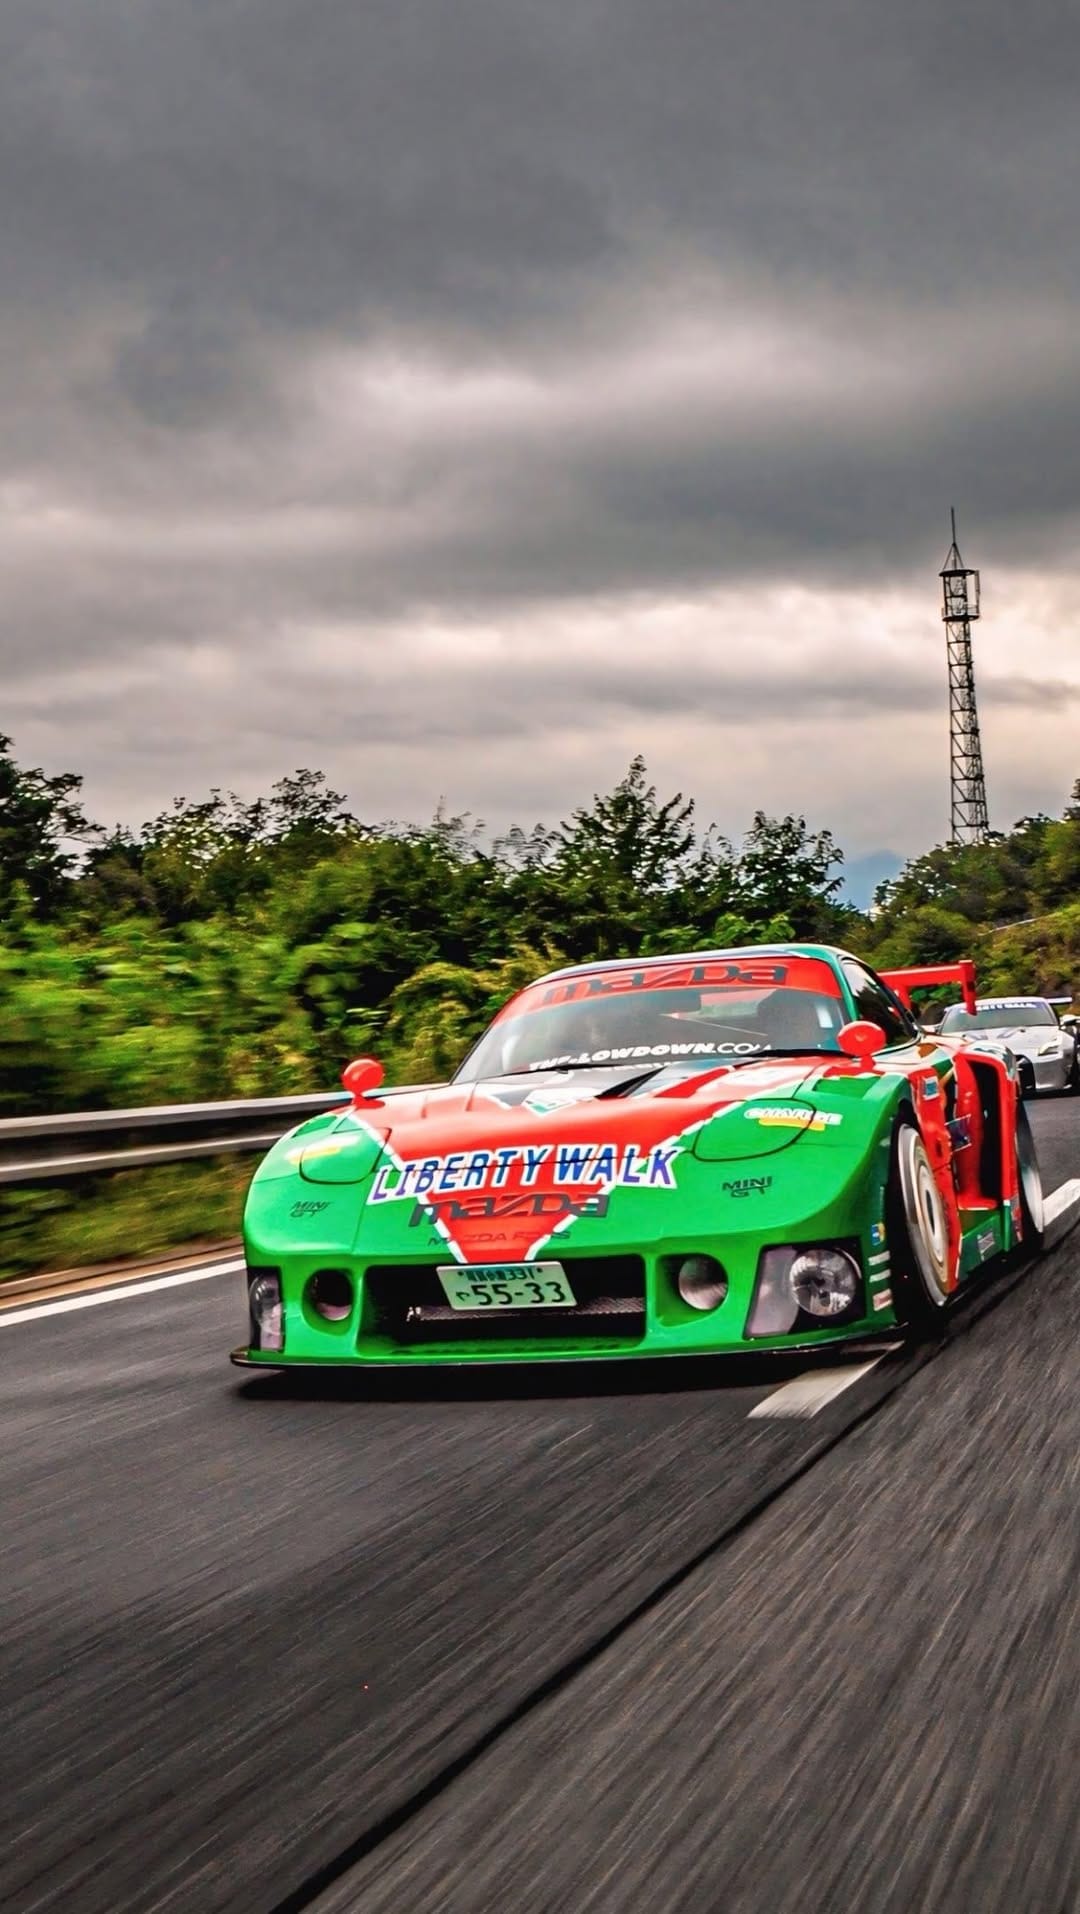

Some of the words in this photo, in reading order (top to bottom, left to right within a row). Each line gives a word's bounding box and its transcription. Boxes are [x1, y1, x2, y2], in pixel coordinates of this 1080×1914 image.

[367, 1146, 549, 1204] LIBERTY
[556, 1144, 678, 1188] WALK
[722, 1175, 773, 1191] MINI
[427, 1232, 507, 1247] MZDA
[470, 1281, 567, 1306] 55-33
